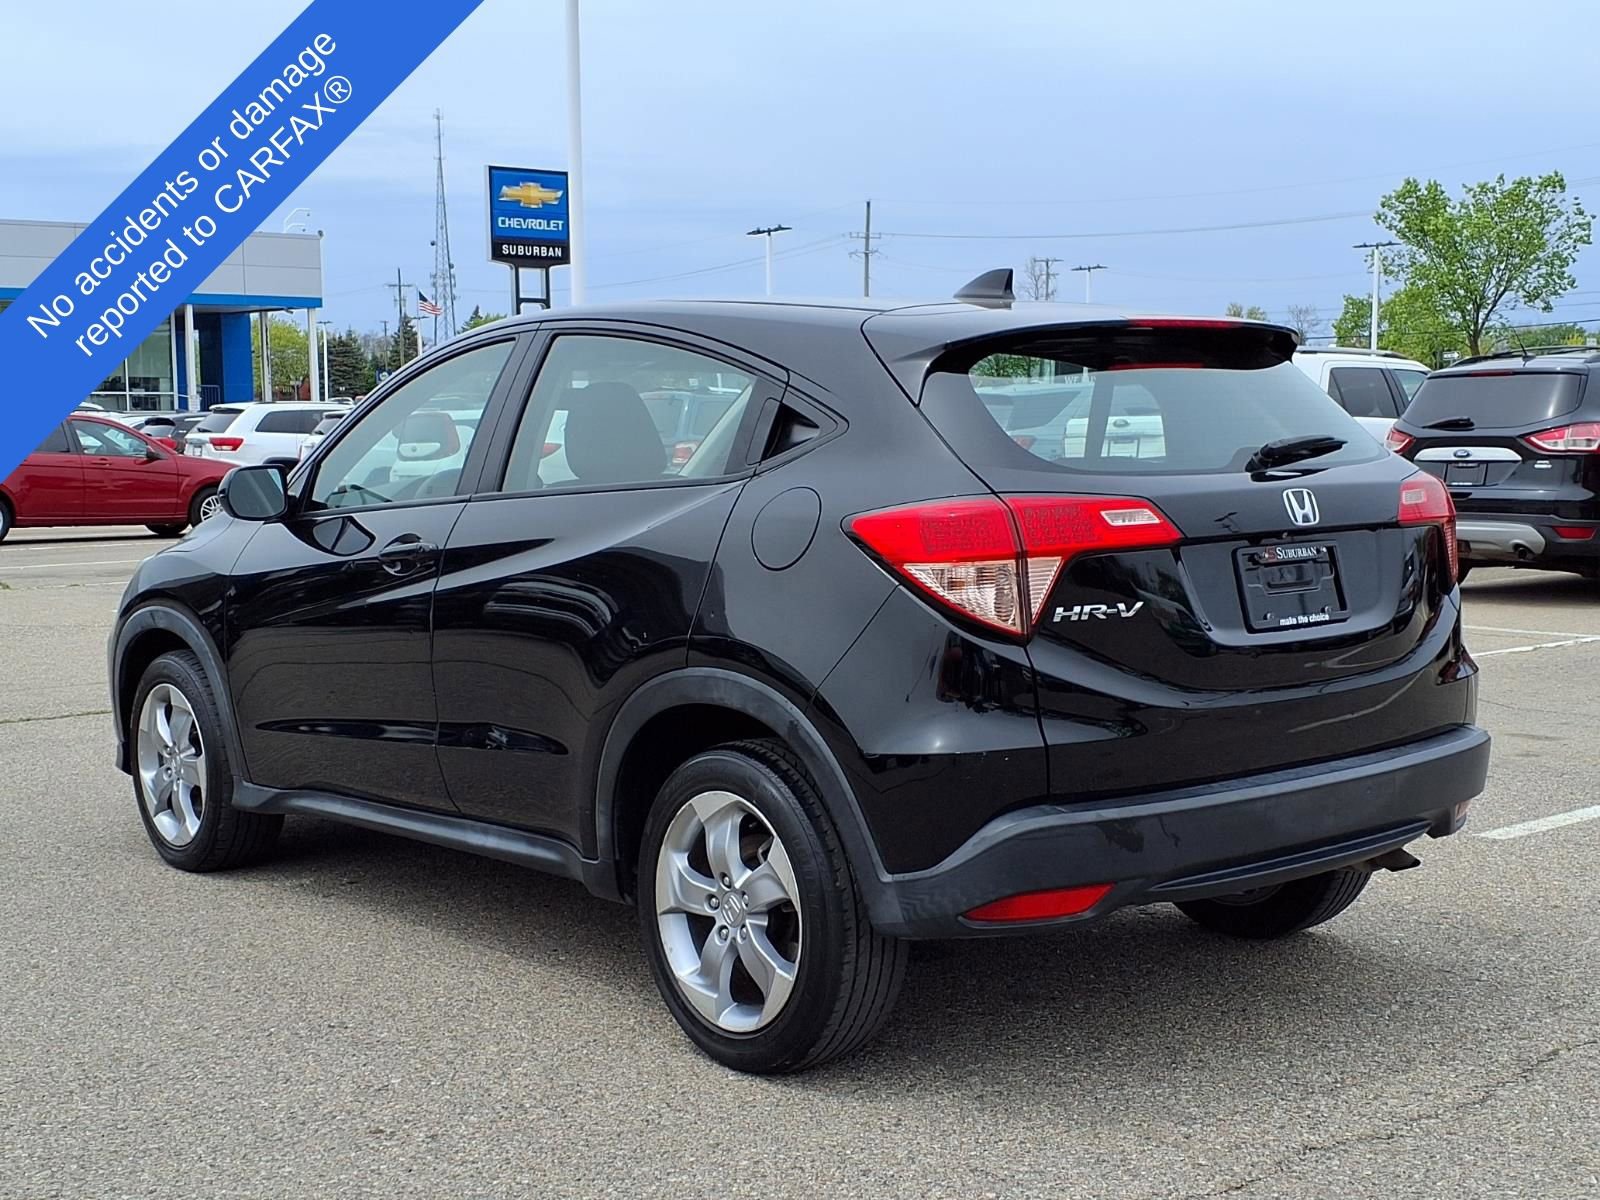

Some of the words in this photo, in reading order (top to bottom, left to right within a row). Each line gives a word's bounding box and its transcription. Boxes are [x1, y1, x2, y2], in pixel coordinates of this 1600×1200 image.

[498, 217, 564, 231] CHEVROLET
[502, 244, 562, 257] SUBURBAN
[1053, 601, 1144, 622] HR-V
[1279, 616, 1297, 626] make
[1297, 615, 1308, 624] the
[1309, 612, 1330, 623] choice
